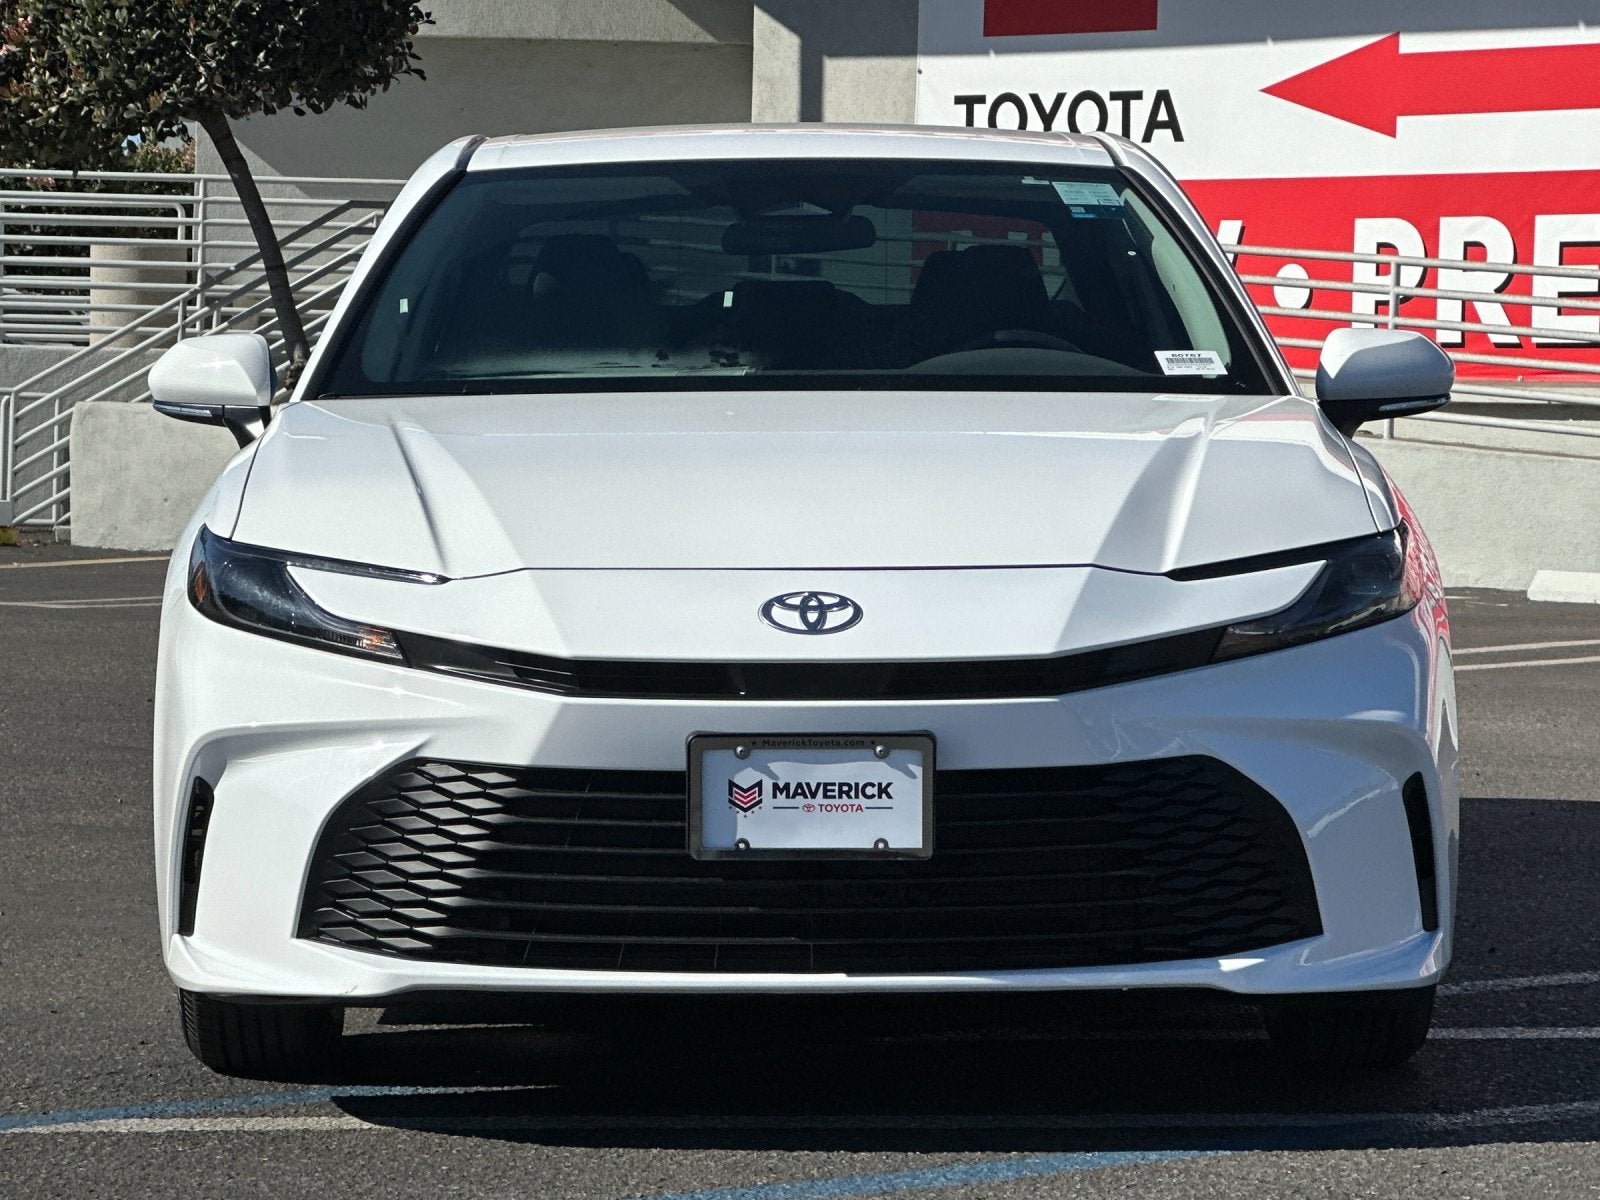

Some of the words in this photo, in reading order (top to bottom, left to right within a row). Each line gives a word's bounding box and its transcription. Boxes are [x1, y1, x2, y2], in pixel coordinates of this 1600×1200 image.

[954, 89, 1185, 143] TOYOTA
[1351, 214, 1600, 347] PRE
[762, 739, 865, 747] MaverickToyota.com
[772, 781, 894, 800] MAVERICK
[818, 803, 864, 813] TOYOTA
